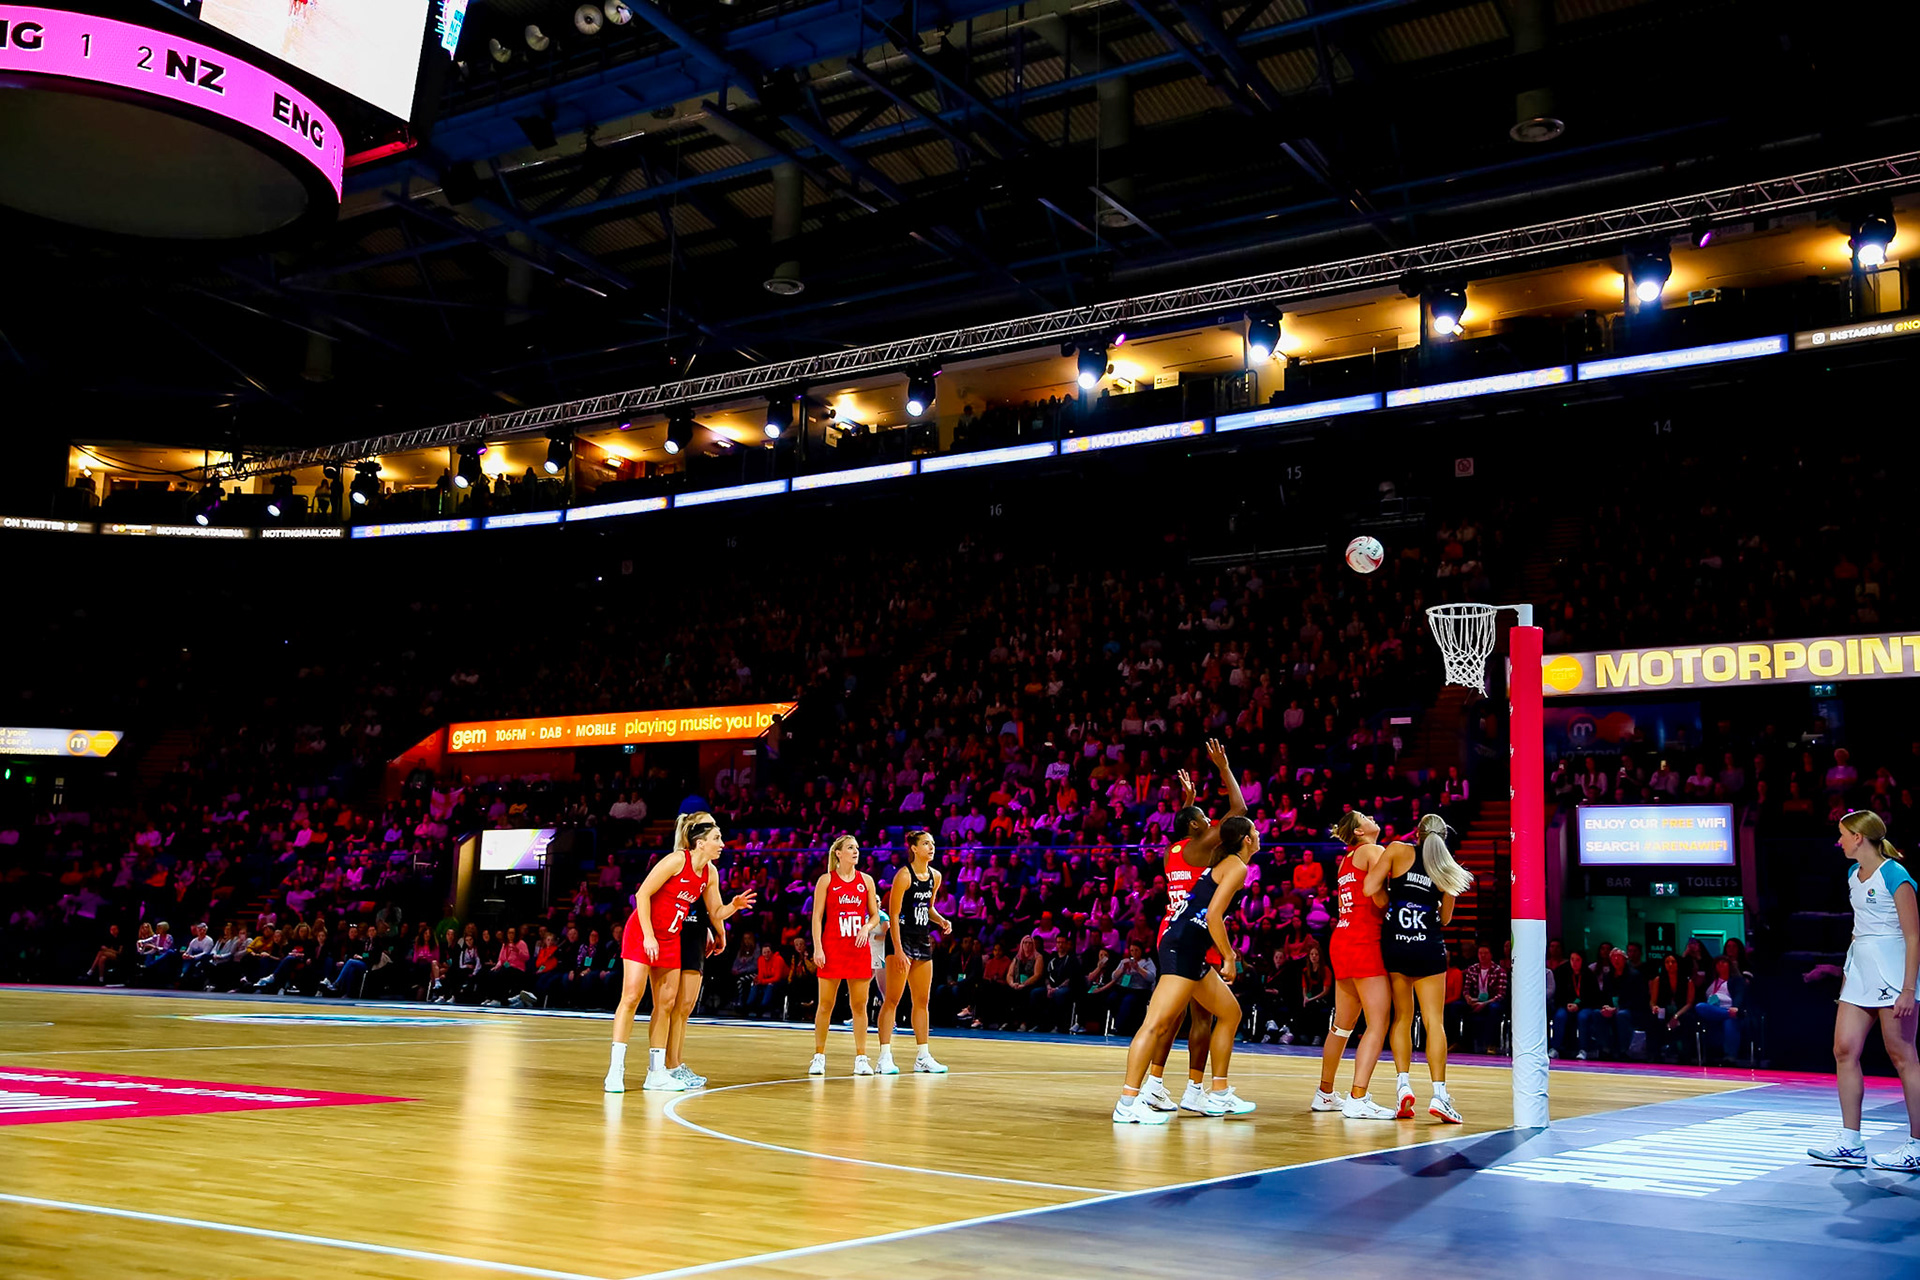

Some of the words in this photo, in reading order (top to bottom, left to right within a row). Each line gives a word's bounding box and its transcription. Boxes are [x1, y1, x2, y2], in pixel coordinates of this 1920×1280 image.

[81, 33, 92, 58] 1
[137, 45, 154, 72] 2
[165, 48, 226, 96] NZ
[272, 91, 325, 150] ENG
[1830, 324, 1893, 341] INSTAGRAM
[1424, 373, 1532, 400] MOTORPOINT
[1653, 419, 1672, 435] 14
[1092, 425, 1179, 449] MOTORPOINT
[1286, 466, 1302, 480] 15
[990, 504, 1002, 517] 16
[3, 519, 20, 529] ON
[22, 520, 65, 531] TWITTER
[262, 527, 341, 539] NOTTINGHAM.COM
[1595, 636, 1920, 688] MOTORPOINT
[452, 727, 487, 750] gem
[495, 728, 526, 742] 106FM
[540, 726, 562, 740] DAB
[576, 723, 617, 737] MOBILE
[625, 718, 677, 738] playing
[680, 714, 722, 732] music
[725, 713, 752, 733] you
[756, 713, 777, 729] lov
[1585, 819, 1627, 830] ENJOY
[1630, 819, 1658, 829] OUR
[1662, 819, 1694, 829] FREE
[1697, 817, 1726, 829] WIFI
[1586, 841, 1640, 852] SEARCH
[1644, 840, 1728, 852] #ARENAWIFI
[1407, 872, 1433, 887] WATSON
[1606, 877, 1632, 888] BAR
[1686, 876, 1739, 887] TOILETS
[838, 894, 862, 907] Vitality
[914, 890, 933, 901] myob
[1398, 907, 1428, 930] GK
[1395, 932, 1427, 944] myob
